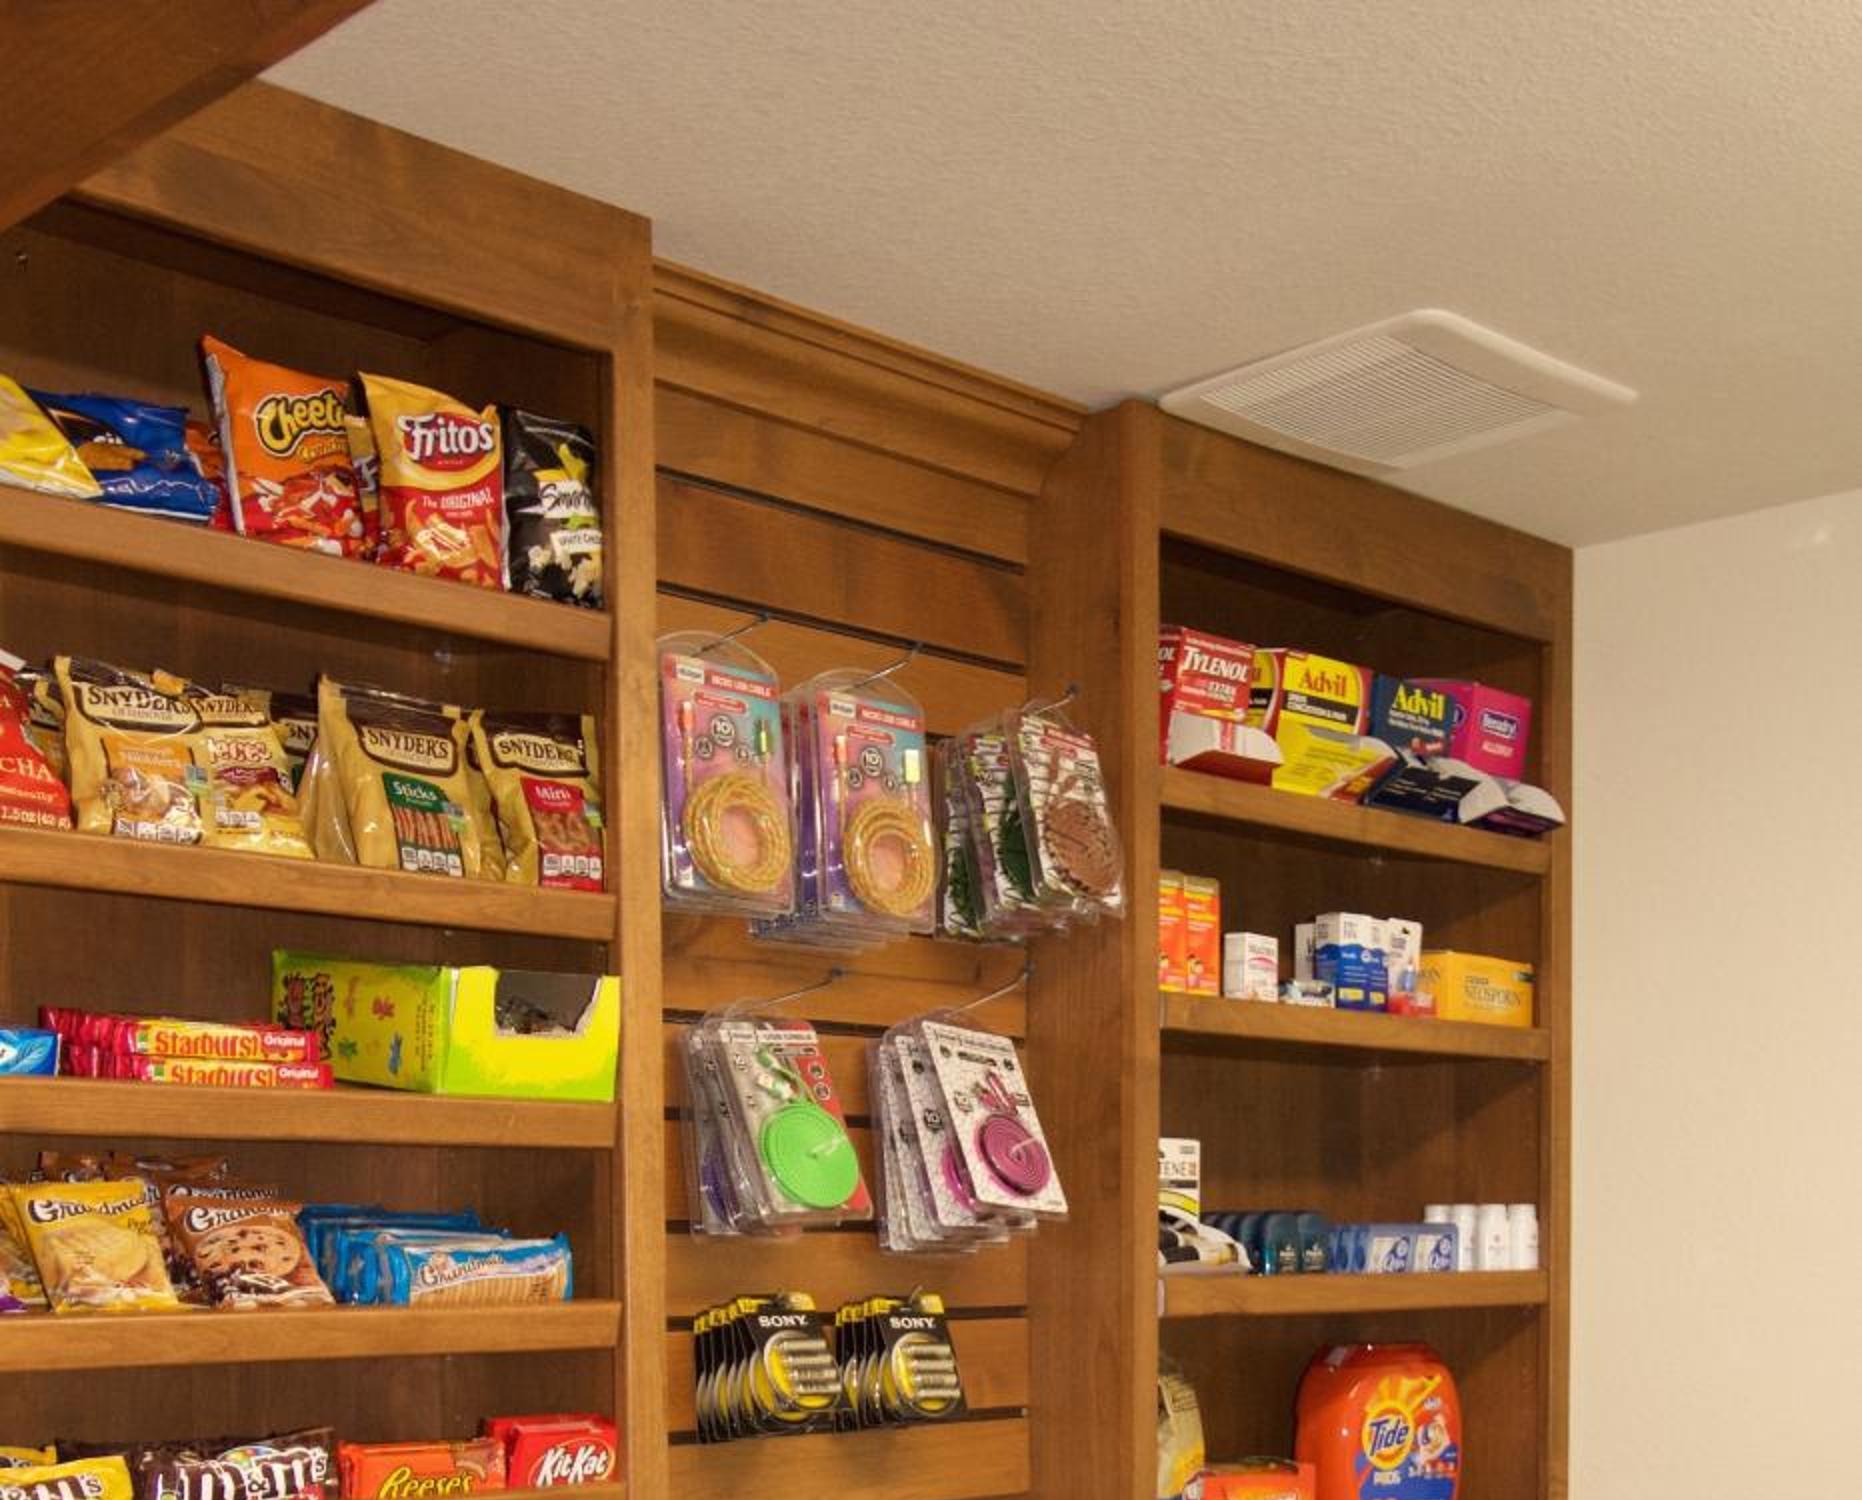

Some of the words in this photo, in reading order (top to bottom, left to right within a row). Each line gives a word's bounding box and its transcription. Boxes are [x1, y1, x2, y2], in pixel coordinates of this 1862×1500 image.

[257, 391, 347, 453] Cheet
[397, 414, 494, 460] Fritos
[1183, 645, 1249, 684] TYLENOL
[1299, 669, 1347, 698] Advil
[1391, 683, 1446, 722] Advil
[154, 1031, 260, 1057] Starburst
[759, 1315, 808, 1328] SONY
[890, 1317, 936, 1329] SONY
[1368, 1418, 1409, 1457] Tide
[379, 1466, 474, 1500] Reese's
